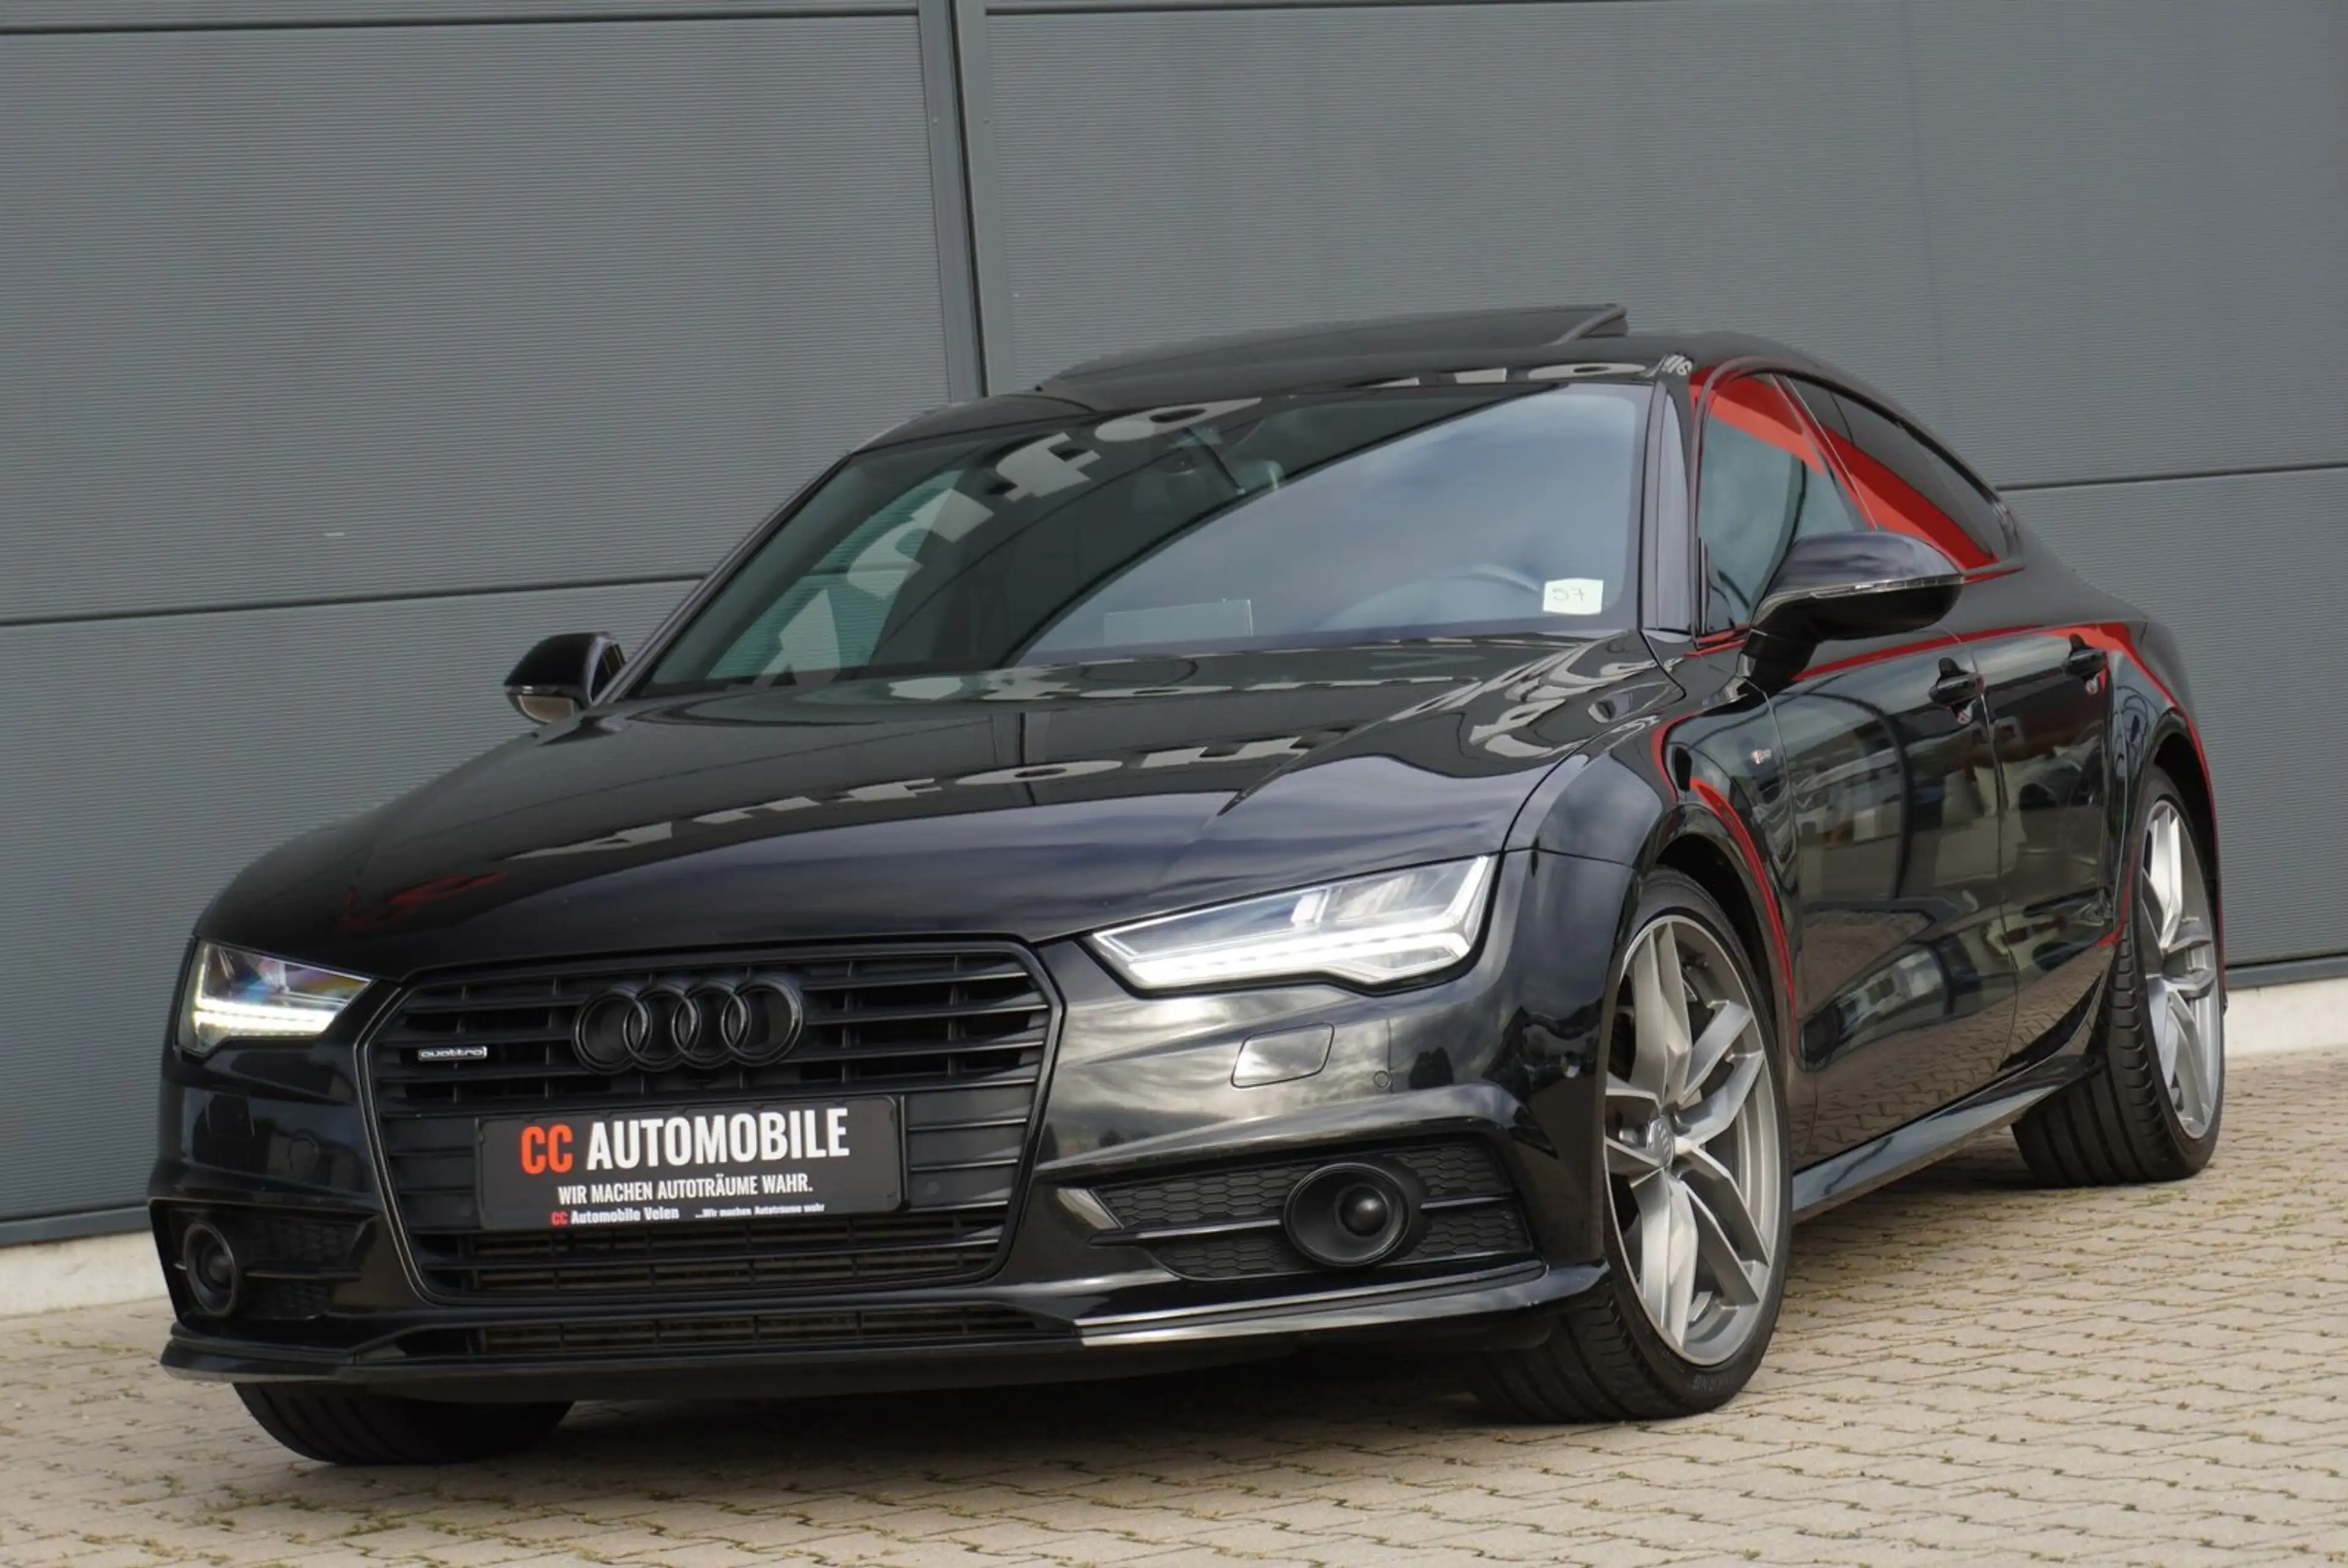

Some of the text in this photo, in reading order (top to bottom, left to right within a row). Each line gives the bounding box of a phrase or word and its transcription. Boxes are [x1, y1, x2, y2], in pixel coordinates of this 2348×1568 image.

[421, 1048, 483, 1058] quattro
[520, 1108, 849, 1174] CC AUTOMOBILE
[558, 1172, 813, 1205] WIR MACHEN AUTOTRÄUME WAHR.
[551, 1211, 568, 1225] CC
[571, 1208, 641, 1224] Automobile
